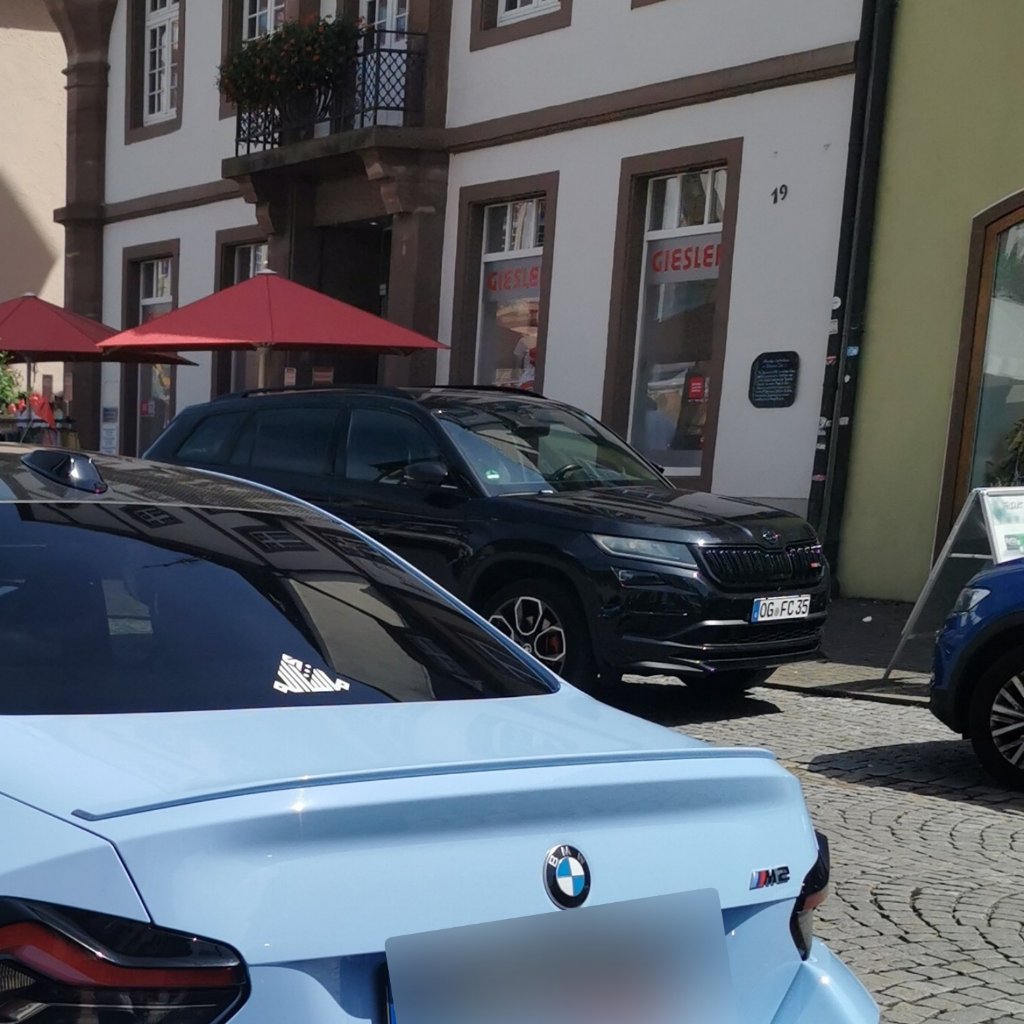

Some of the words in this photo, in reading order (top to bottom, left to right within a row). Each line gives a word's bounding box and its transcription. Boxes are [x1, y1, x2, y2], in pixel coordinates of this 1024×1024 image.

[771, 184, 788, 204] 19
[652, 244, 721, 273] GIESLE
[487, 266, 539, 291] GIESLE
[760, 602, 774, 618] OG
[780, 600, 794, 616] FC
[795, 599, 808, 615] 35
[548, 845, 585, 868] BMW
[758, 865, 790, 889] M2
